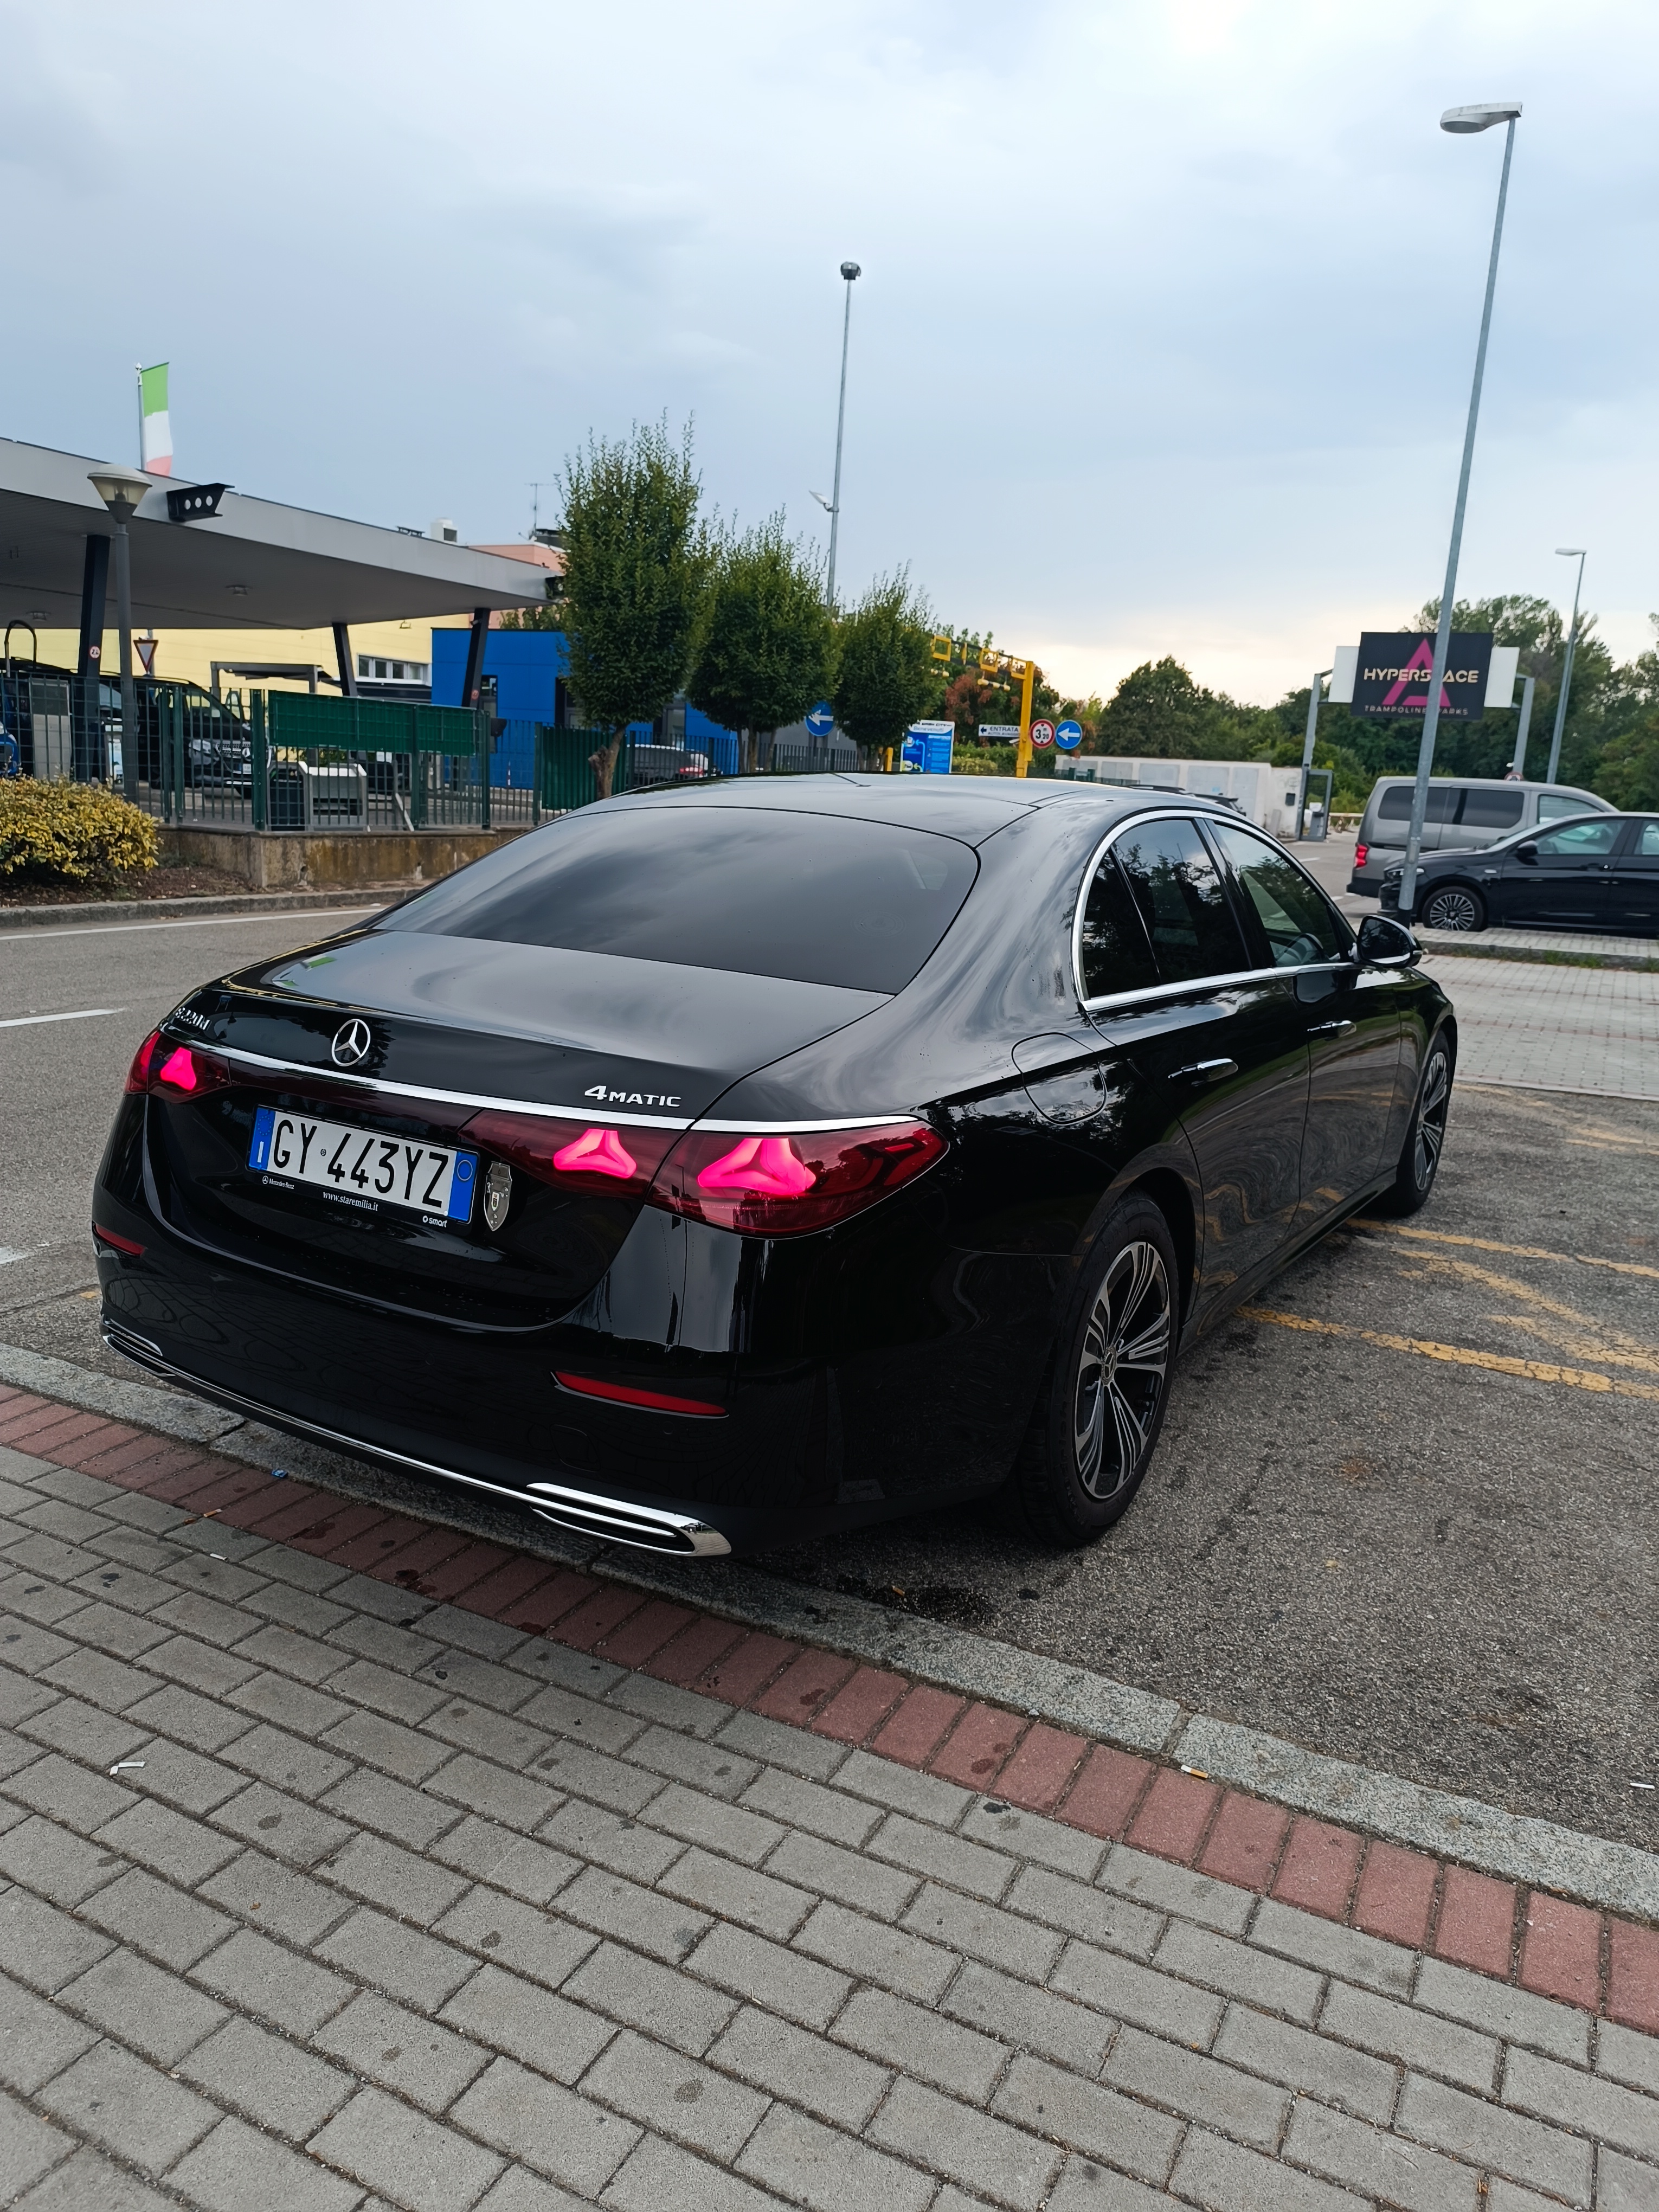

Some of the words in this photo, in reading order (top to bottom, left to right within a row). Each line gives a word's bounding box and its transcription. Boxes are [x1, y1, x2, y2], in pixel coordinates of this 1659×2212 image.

[1364, 667, 1480, 683] HYPERSACE
[1365, 705, 1427, 714] TRAMPOLINE
[323, 1192, 378, 1212] www.staremilia.it
[428, 1217, 448, 1228] smart
